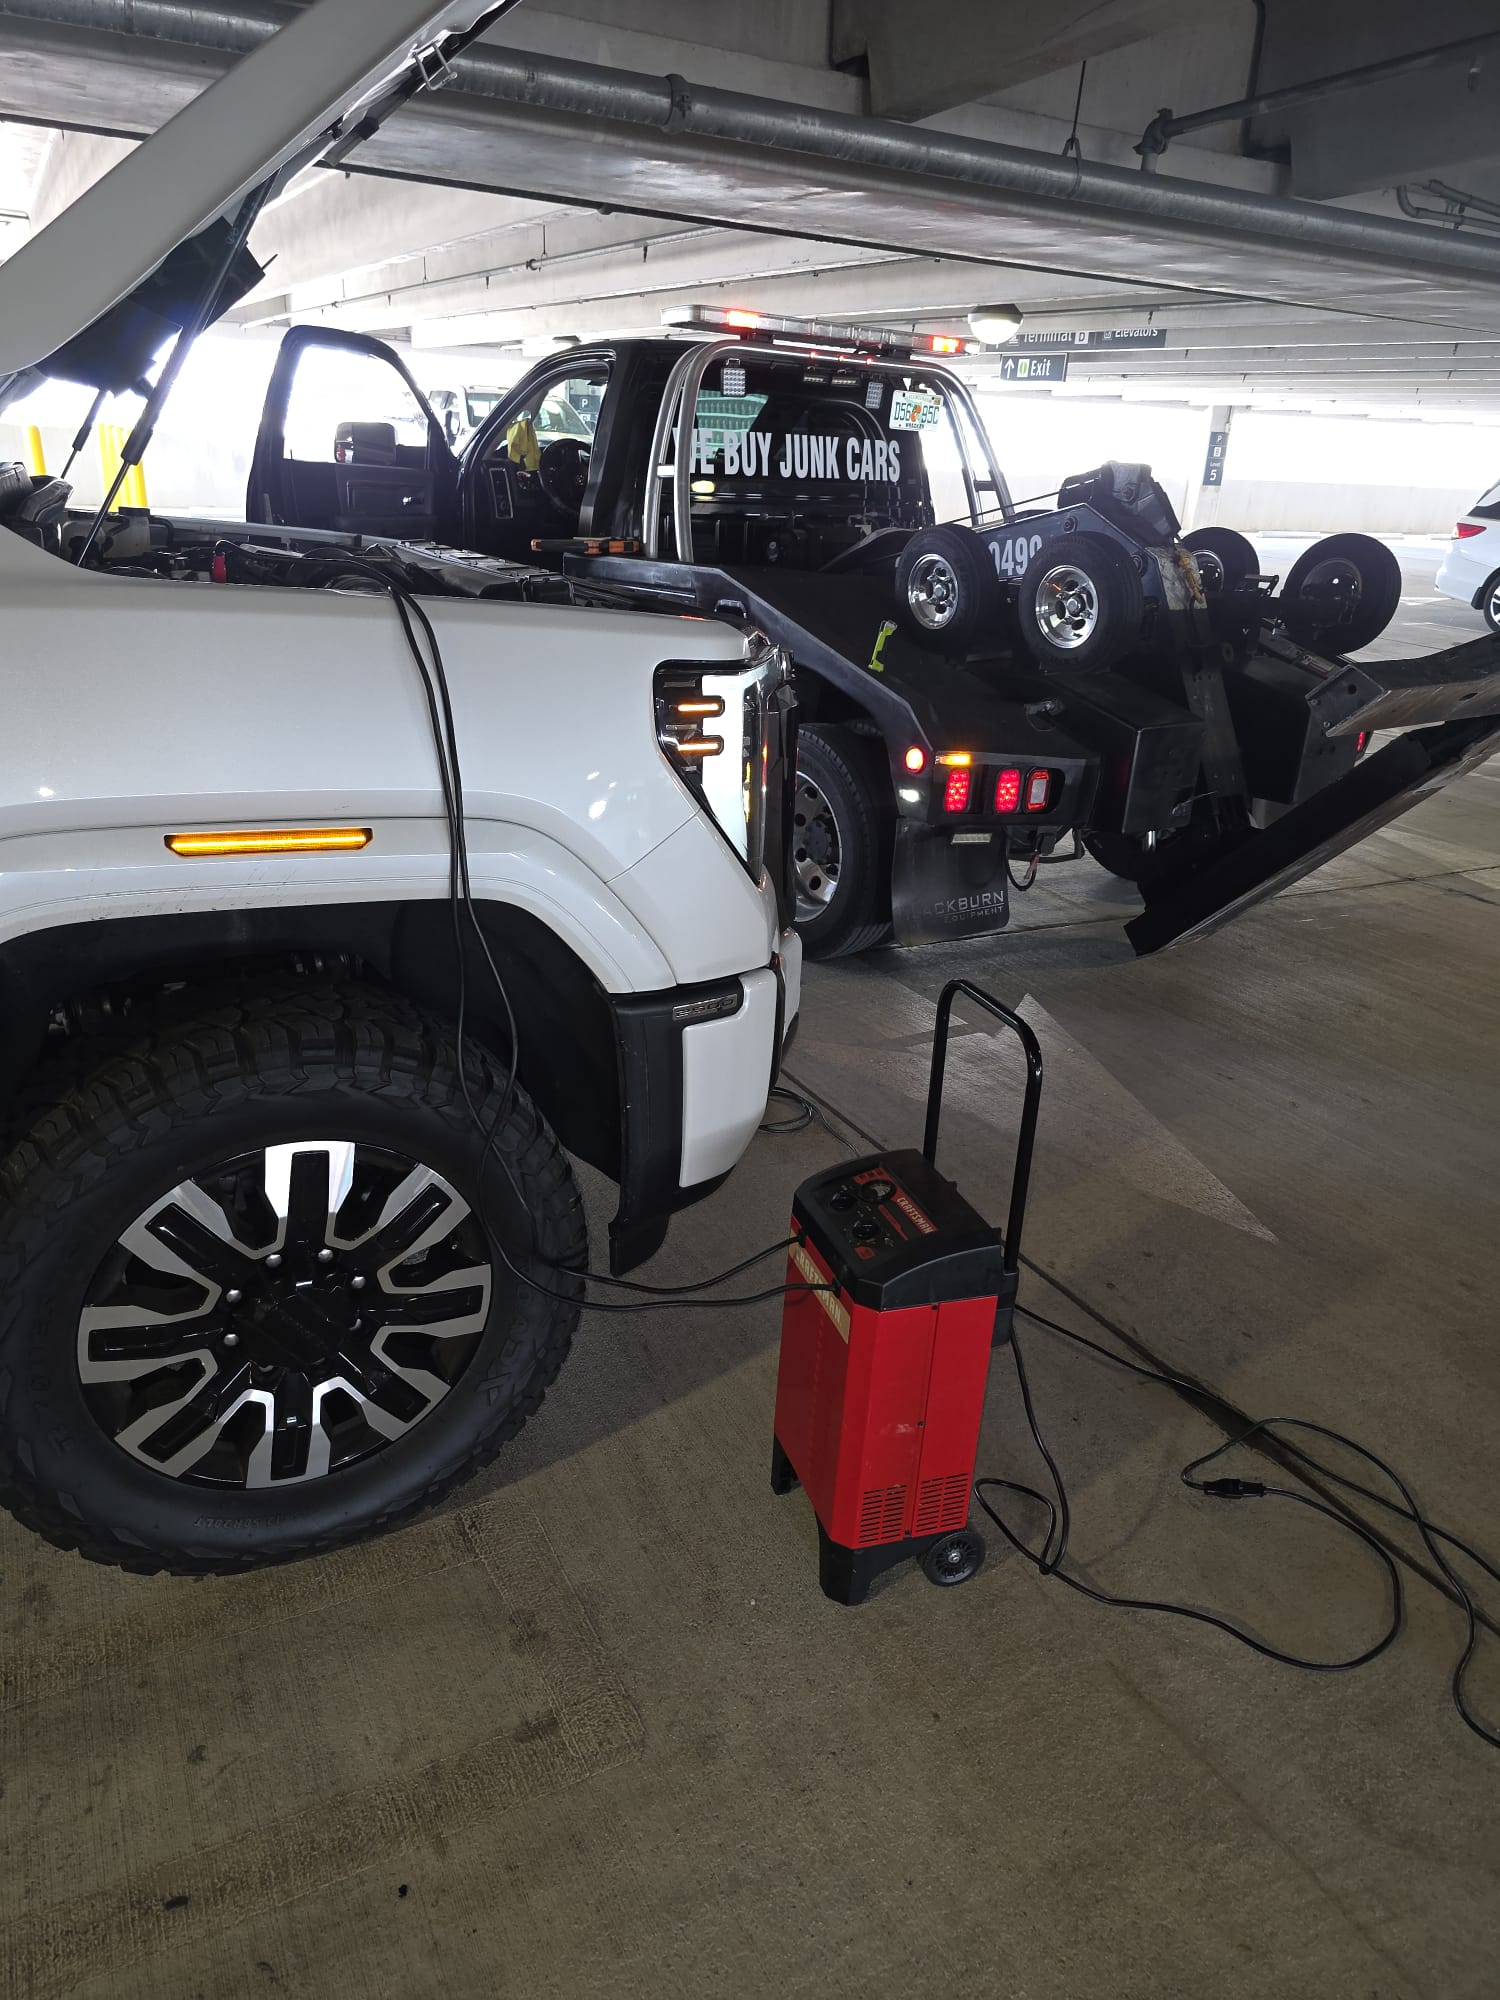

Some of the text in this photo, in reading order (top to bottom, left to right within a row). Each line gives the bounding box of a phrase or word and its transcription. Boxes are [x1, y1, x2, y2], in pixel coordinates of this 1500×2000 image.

[1030, 358, 1051, 377] Exit
[581, 398, 589, 408] P
[724, 431, 773, 477] BUY
[779, 433, 840, 479] JUNK
[846, 437, 901, 483] CARS
[1210, 469, 1217, 481] 5
[896, 1196, 936, 1235] CRAFTSMAN
